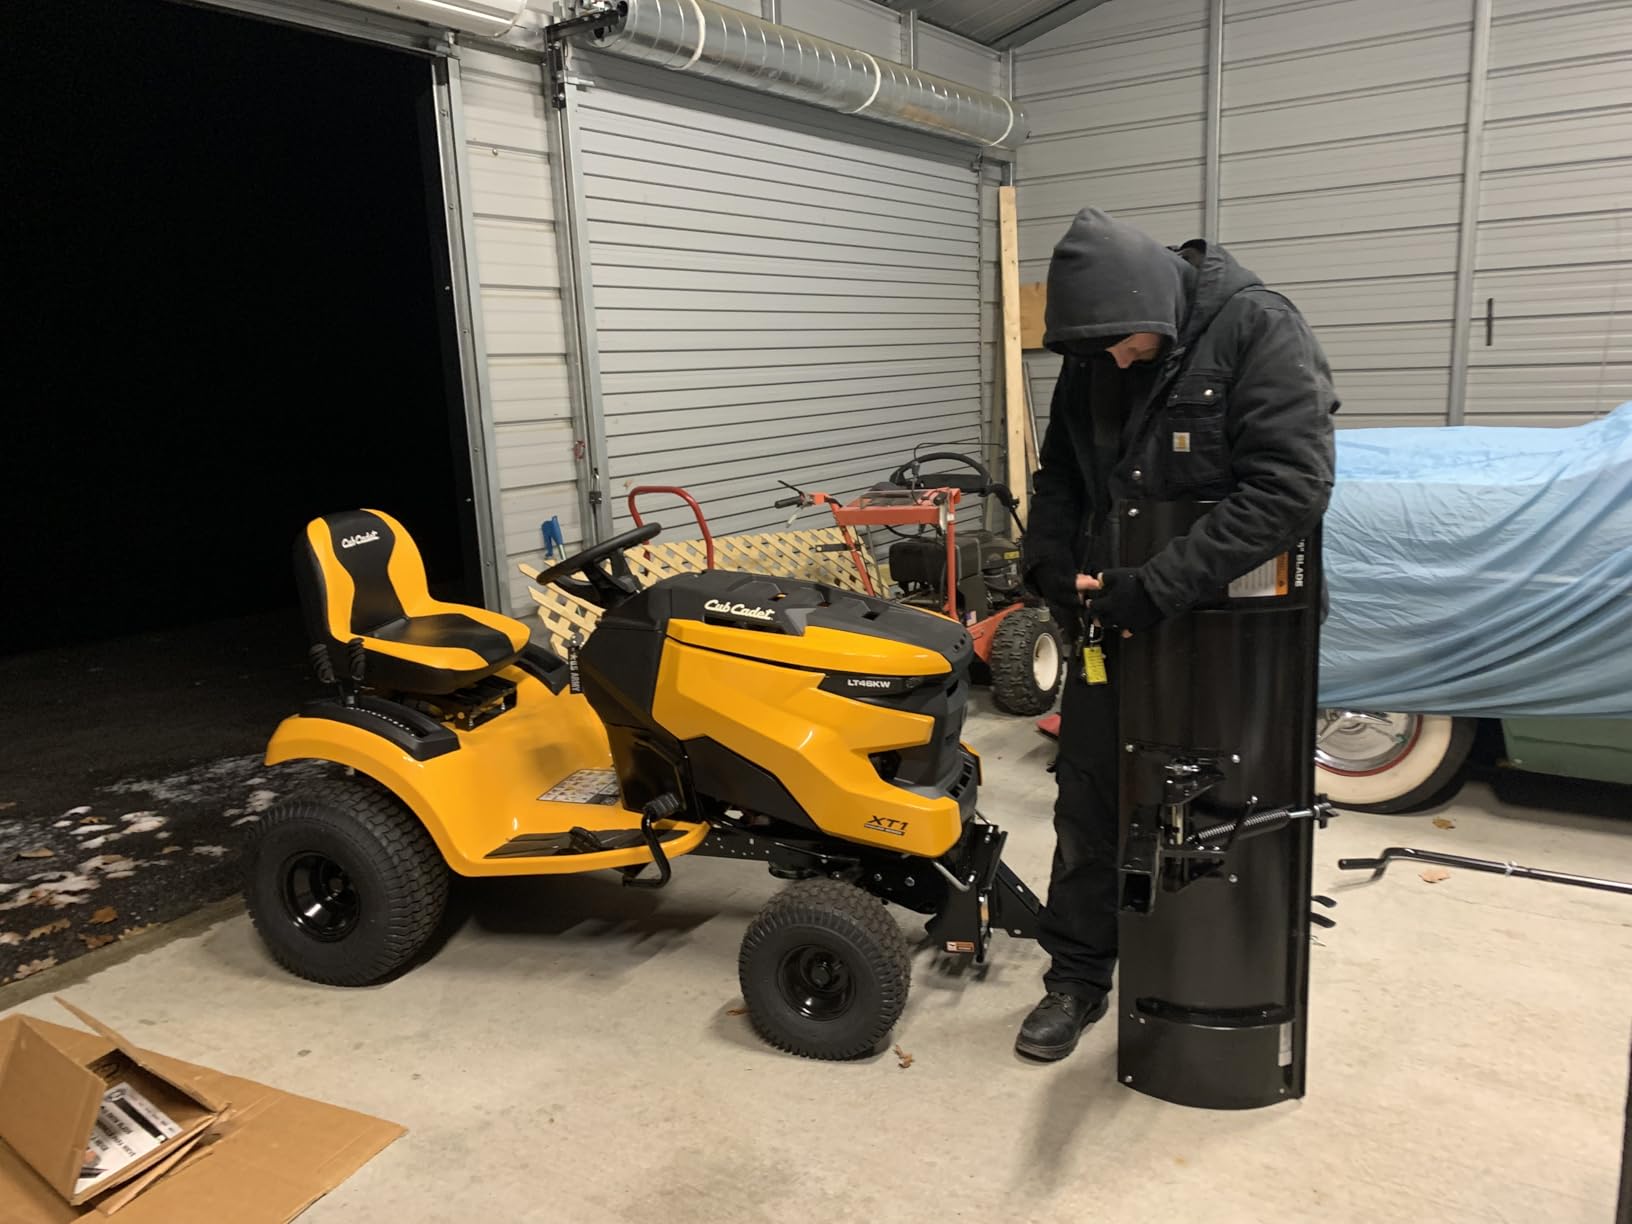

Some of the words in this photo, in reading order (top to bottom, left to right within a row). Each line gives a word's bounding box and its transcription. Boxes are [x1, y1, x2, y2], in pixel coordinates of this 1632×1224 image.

[1295, 554, 1304, 587] BLADE
[704, 599, 731, 613] Cub
[730, 603, 776, 620] Cadet
[867, 815, 908, 830] XT1
